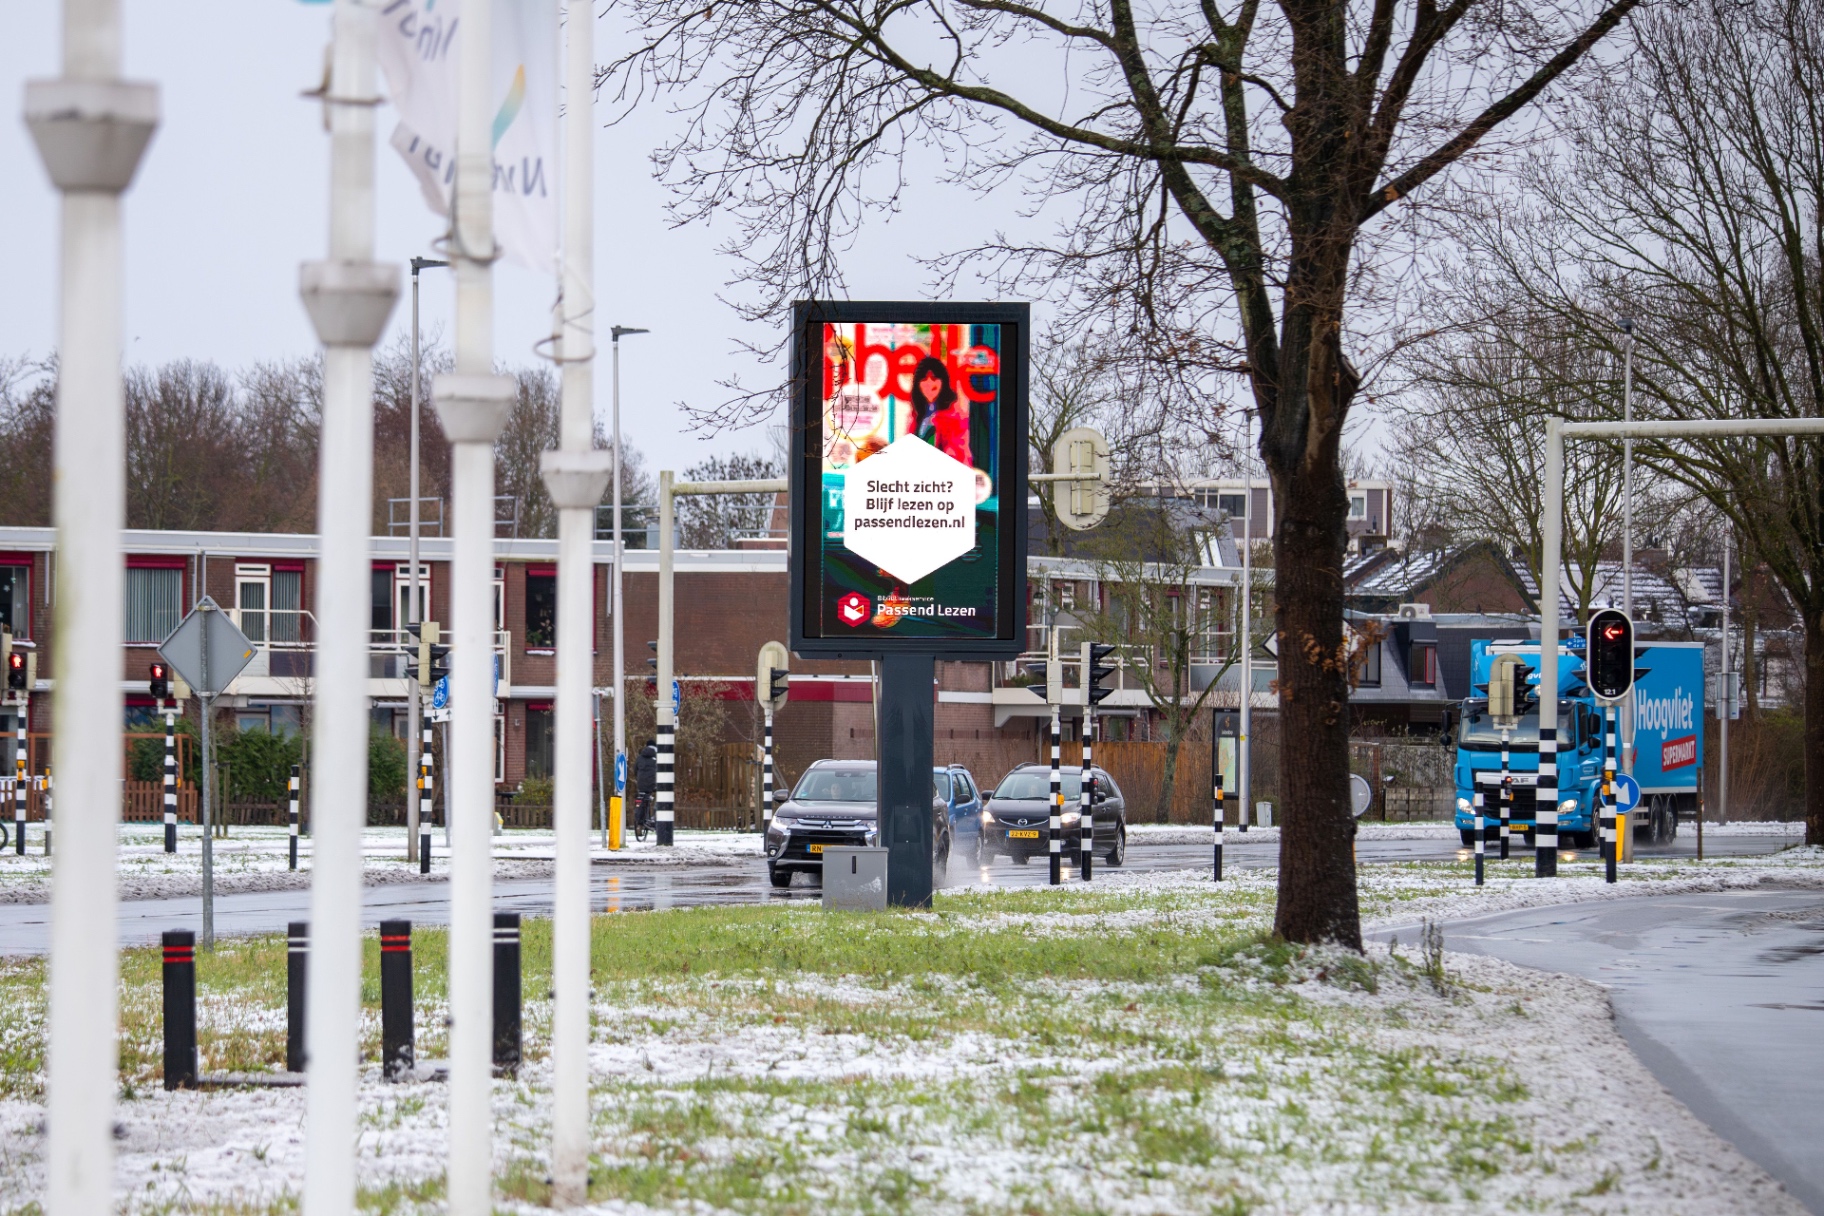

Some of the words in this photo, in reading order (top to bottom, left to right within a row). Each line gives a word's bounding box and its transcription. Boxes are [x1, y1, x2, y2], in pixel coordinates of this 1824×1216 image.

[867, 480, 910, 492] Slecht
[914, 480, 953, 492] zicht?
[866, 498, 894, 513] Blijf
[897, 498, 934, 510] lezen
[937, 501, 955, 514] op
[854, 515, 965, 530] passendlezen.nl
[877, 603, 934, 616] Passend
[937, 604, 976, 616] Lezen
[1638, 686, 1694, 740] Hoogvliet
[1663, 740, 1695, 766] SUPERMARKT
